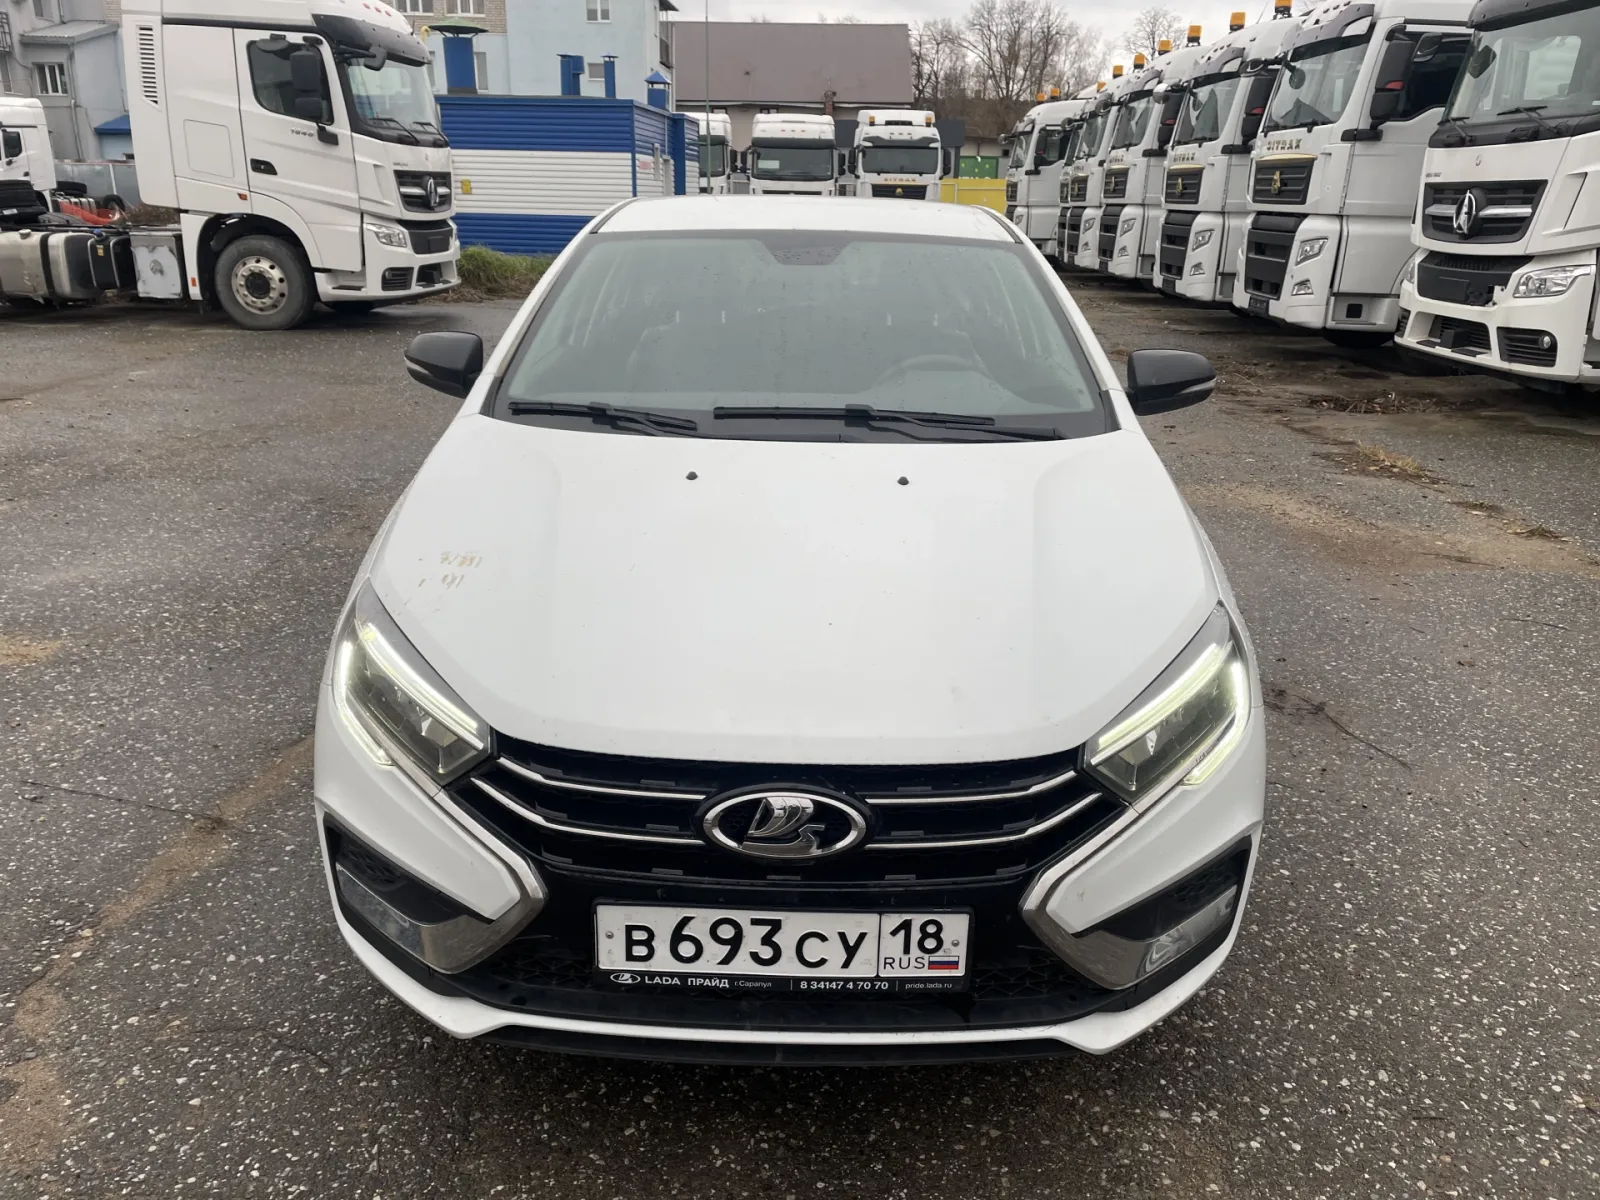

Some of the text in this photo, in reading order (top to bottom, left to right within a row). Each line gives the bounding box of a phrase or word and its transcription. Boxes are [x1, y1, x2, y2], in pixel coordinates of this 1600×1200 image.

[625, 916, 868, 969] В693СУ
[889, 918, 944, 955] 18
[883, 956, 926, 970] RUS
[645, 976, 681, 986] LADA
[688, 977, 729, 988] ПРАЙД
[800, 981, 889, 990] 8 34147 4 70 70
[905, 982, 953, 990] pride.lada.ru
